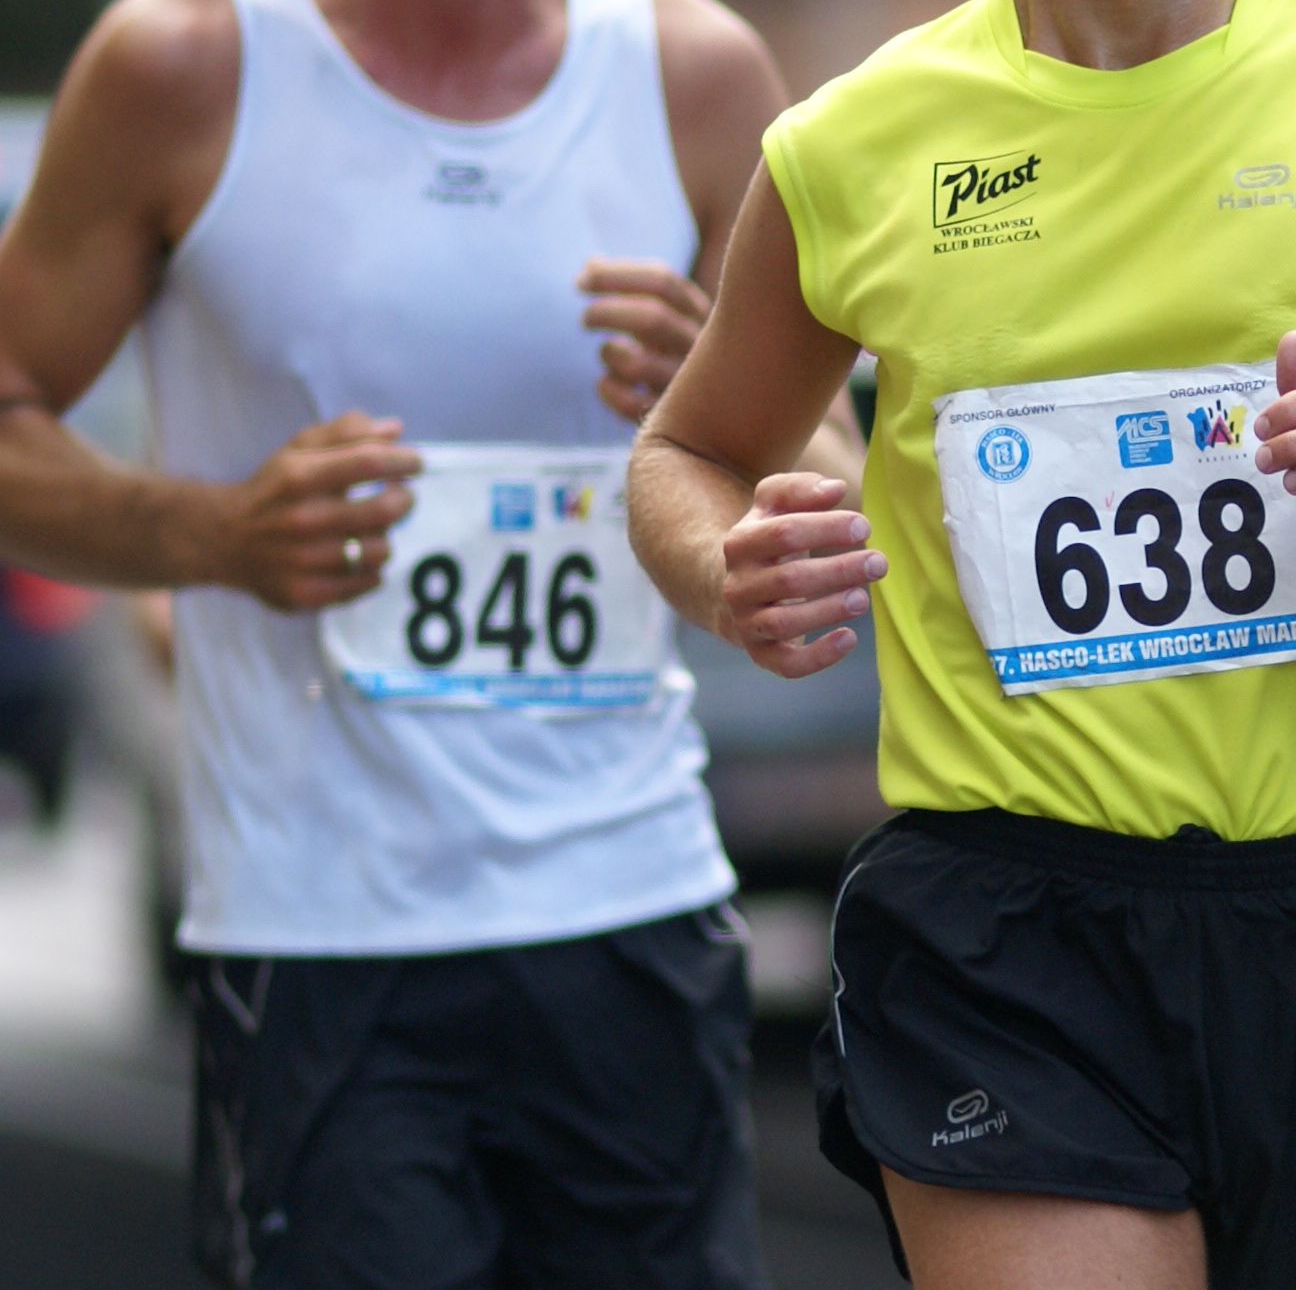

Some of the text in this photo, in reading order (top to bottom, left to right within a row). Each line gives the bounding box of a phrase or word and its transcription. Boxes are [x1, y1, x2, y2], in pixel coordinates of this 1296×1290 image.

[941, 154, 1041, 219] Piast
[933, 230, 1042, 255] KLUB BIEGACZA
[1169, 380, 1266, 399] ORGANIZATORZY
[950, 408, 1004, 424] SPONSOR
[1035, 478, 1275, 635] 638
[407, 552, 598, 672] 846
[989, 656, 1015, 677] 7.
[1019, 641, 1136, 674] HASCO-LEK
[1138, 627, 1250, 660] WROCŁAW
[932, 1110, 1008, 1147] Kalenji
